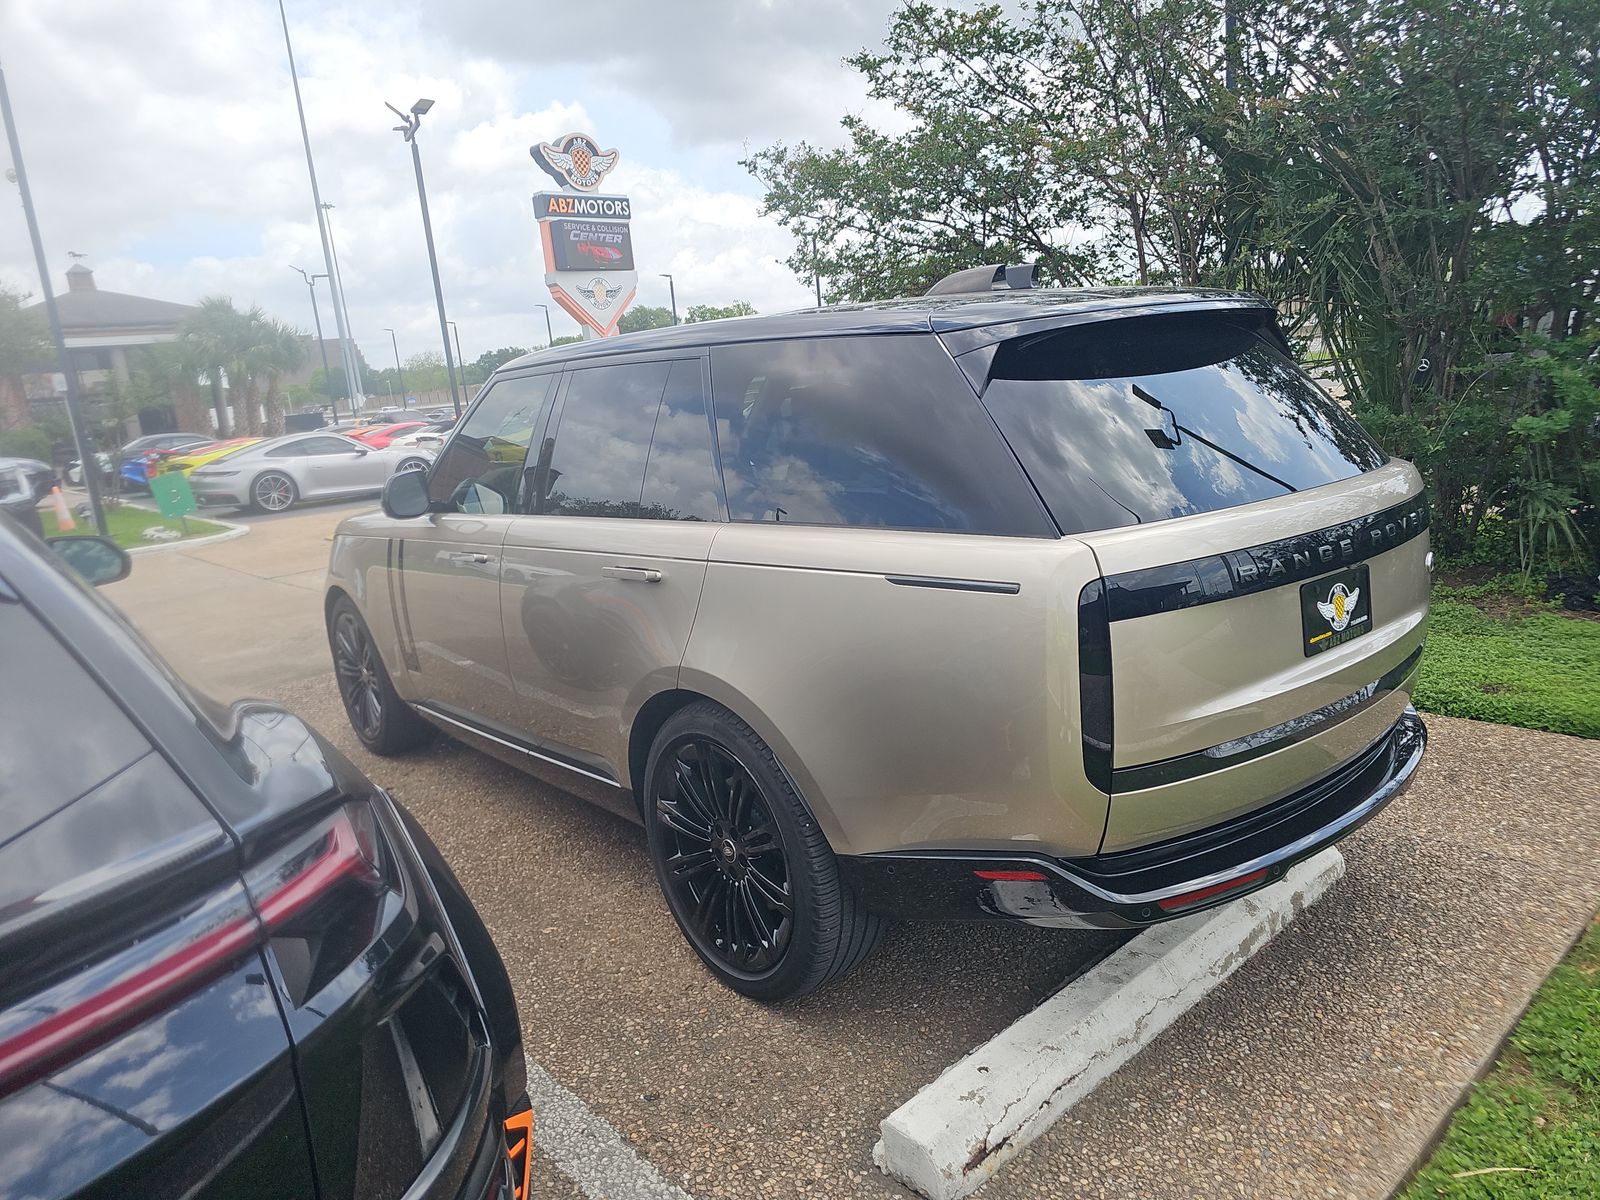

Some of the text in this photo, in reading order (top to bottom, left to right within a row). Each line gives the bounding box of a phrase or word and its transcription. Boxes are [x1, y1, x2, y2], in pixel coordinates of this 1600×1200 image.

[571, 173, 599, 187] MOTORS
[563, 222, 591, 231] SERVICE
[596, 224, 629, 234] COLLISION
[569, 229, 623, 243] CENTER
[1235, 538, 1353, 583] RANGE
